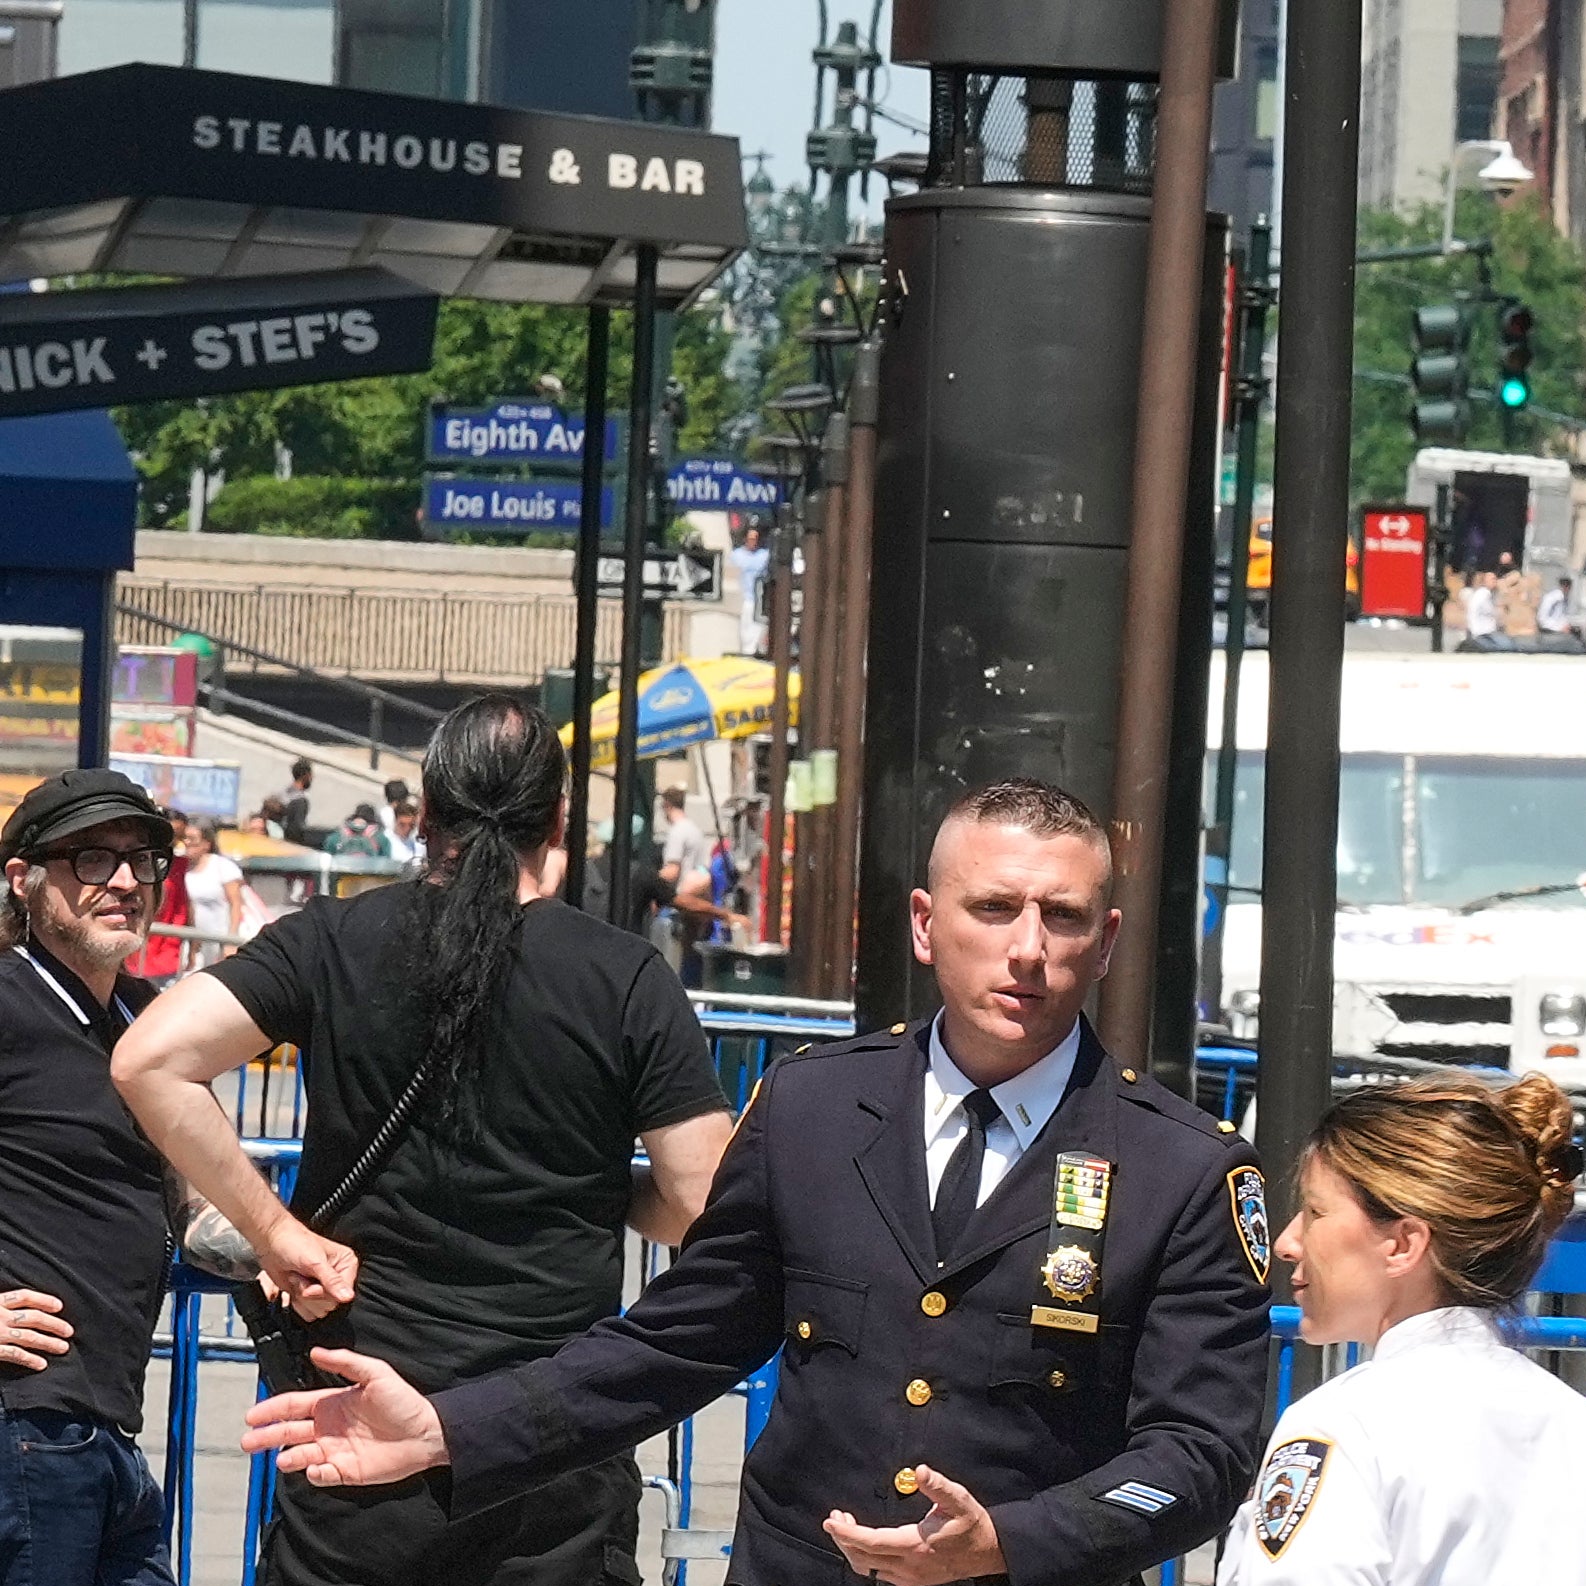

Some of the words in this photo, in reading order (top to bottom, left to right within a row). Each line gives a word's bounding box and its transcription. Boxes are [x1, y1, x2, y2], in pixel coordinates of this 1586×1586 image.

[193, 115, 523, 179] STEAKHOUSE
[548, 148, 582, 186] &
[608, 153, 705, 197] BAR
[136, 339, 168, 371] +
[191, 308, 380, 371] STEF'S
[446, 419, 539, 456] Eighth
[545, 423, 586, 452] Av
[441, 490, 485, 519] Joe
[491, 490, 556, 520] Louis
